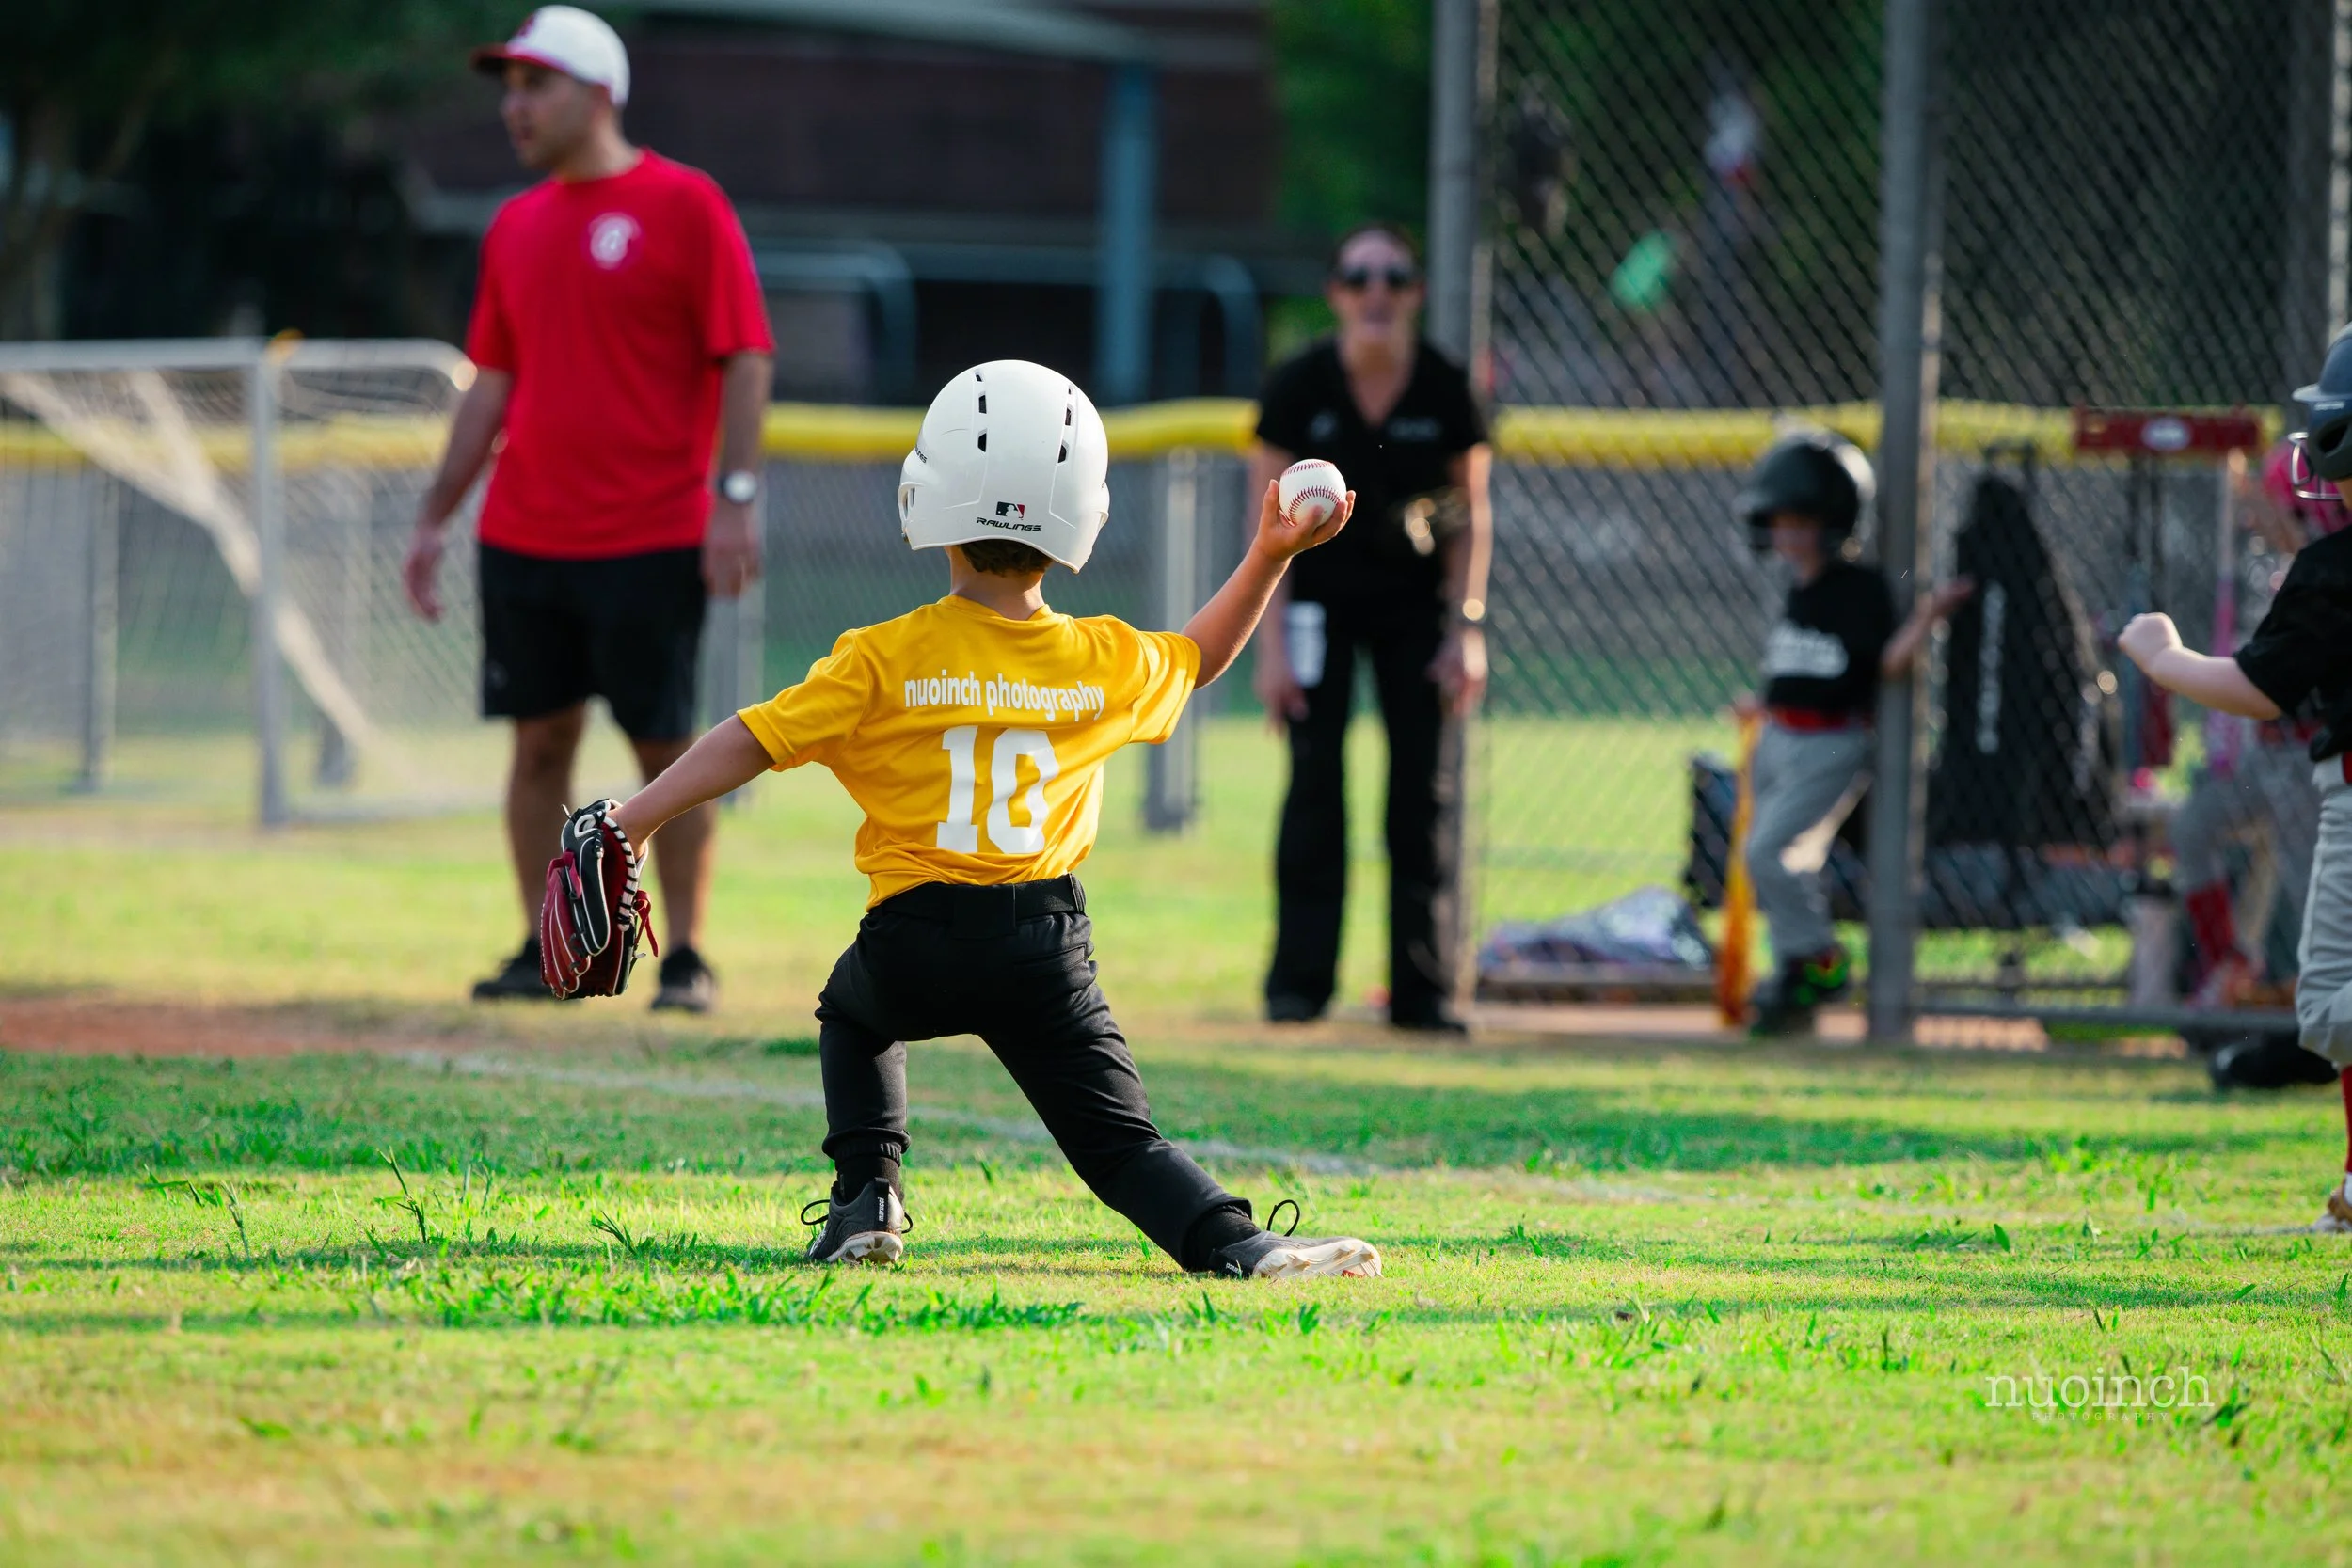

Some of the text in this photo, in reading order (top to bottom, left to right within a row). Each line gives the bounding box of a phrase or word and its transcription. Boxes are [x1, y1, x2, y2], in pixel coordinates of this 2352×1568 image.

[976, 516, 1041, 531] RAWLINGS
[904, 669, 1104, 722] nuoinch photography
[936, 725, 1059, 854] 10
